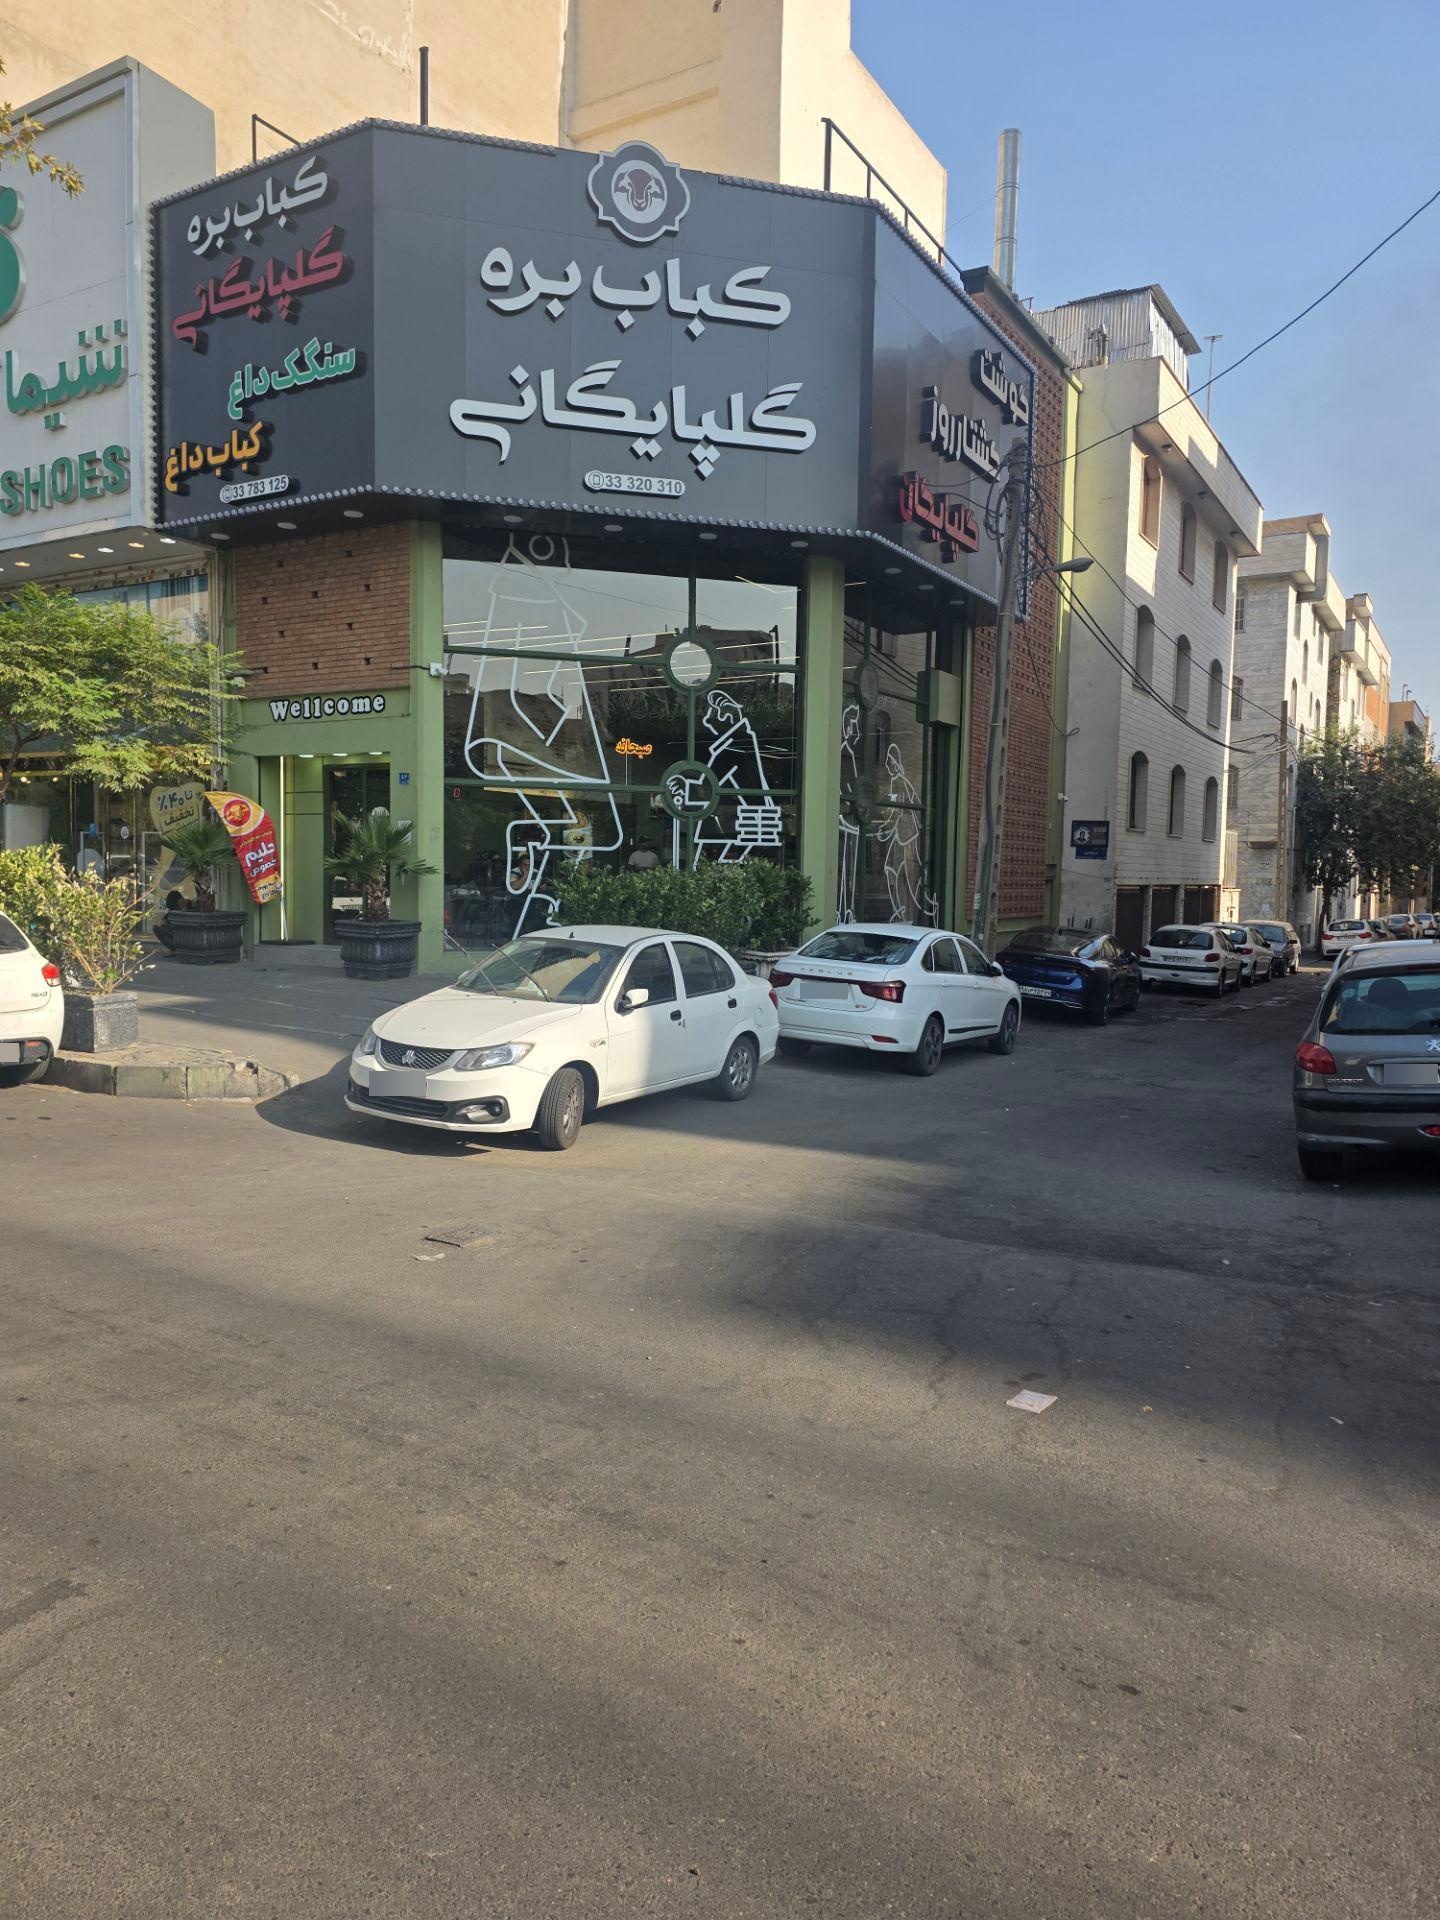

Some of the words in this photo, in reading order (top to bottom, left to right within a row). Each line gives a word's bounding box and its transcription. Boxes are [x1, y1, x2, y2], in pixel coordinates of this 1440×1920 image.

[233, 155, 328, 241] کباب
[187, 203, 231, 256] بره
[172, 226, 345, 350] گلپایگانی
[480, 246, 582, 319] بره
[591, 257, 792, 339] کباب
[227, 363, 270, 420] داغ
[272, 337, 357, 391] سنگک
[449, 359, 818, 479] گلپایگانی
[163, 440, 204, 493] داغ
[206, 421, 265, 477] کباب
[0, 445, 127, 516] SHOES
[232, 485, 245, 499] 33
[247, 480, 266, 495] 783
[268, 476, 287, 492] 125
[605, 474, 622, 489] 33
[627, 476, 652, 492] 320
[657, 479, 682, 494] 310
[269, 694, 387, 722] Wellcome
[244, 841, 276, 868] حلیم
